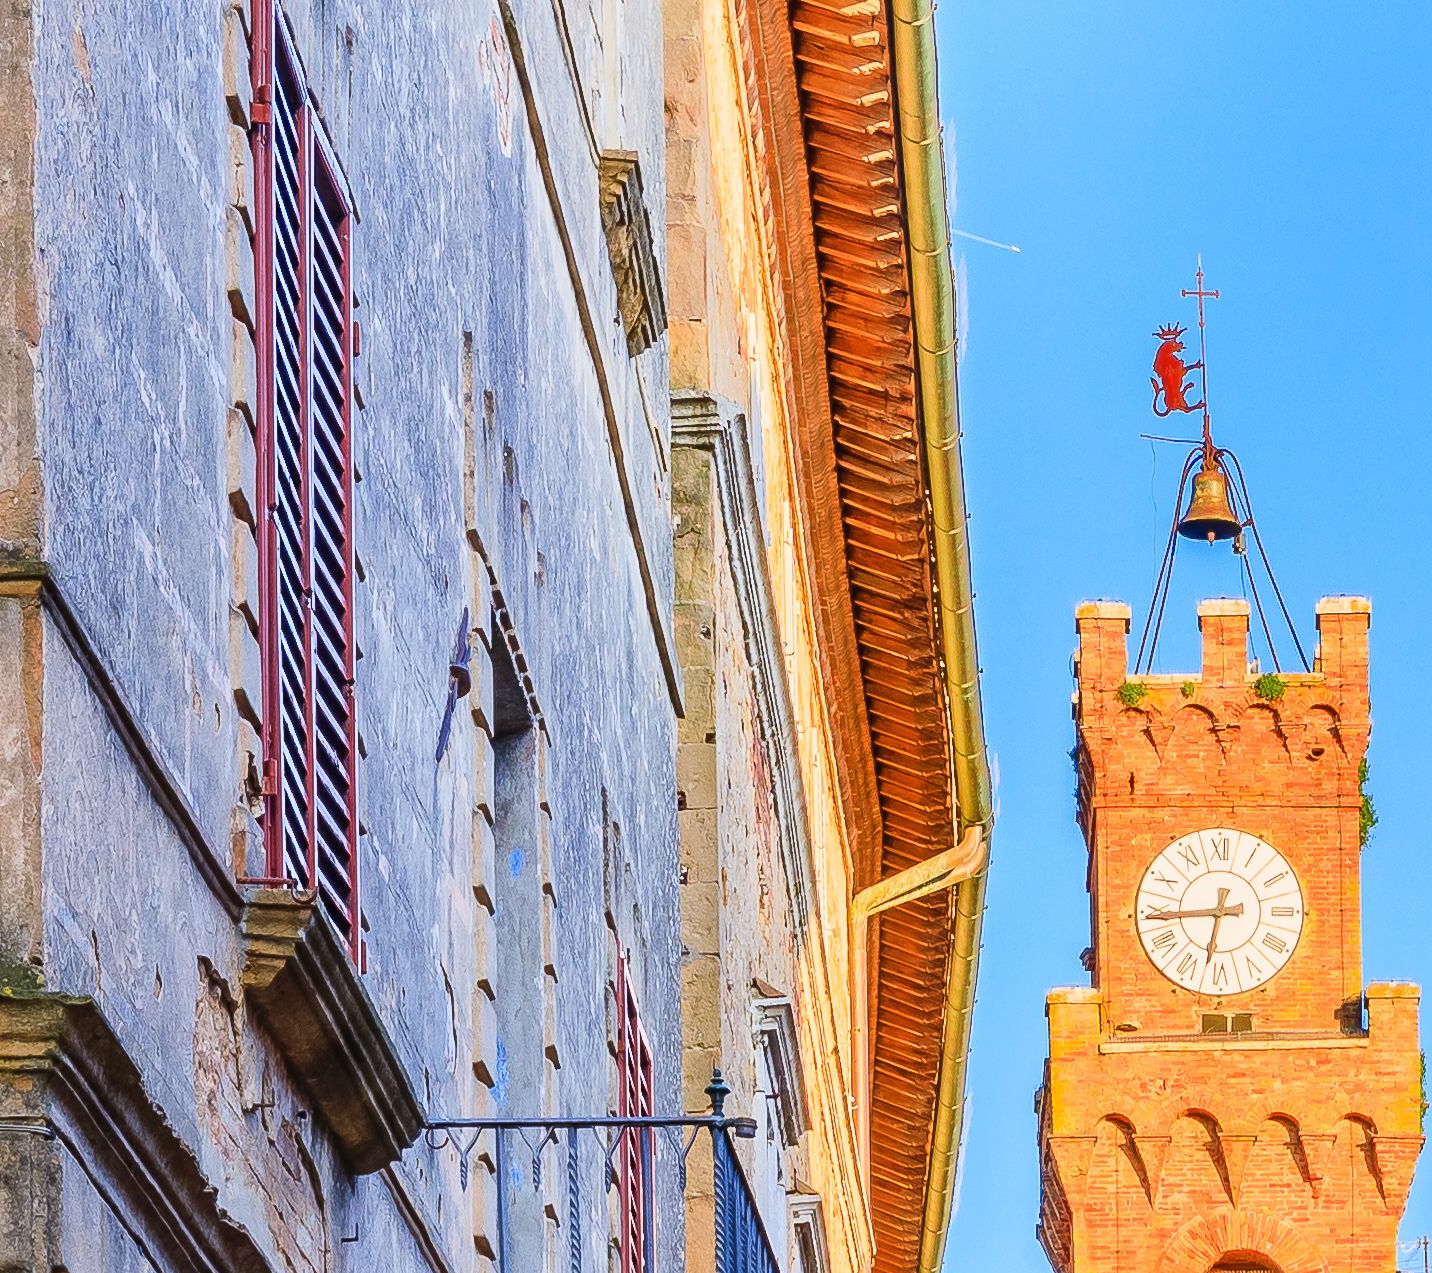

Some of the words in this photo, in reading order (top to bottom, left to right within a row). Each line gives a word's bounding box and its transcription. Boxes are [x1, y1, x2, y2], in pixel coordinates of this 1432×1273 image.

[1177, 844, 1200, 872] XI
[1211, 838, 1229, 861] XII
[1244, 848, 1257, 868] I
[1154, 870, 1179, 893] X
[1264, 873, 1285, 888] II
[1272, 907, 1294, 917] III
[1152, 930, 1178, 958] VIII
[1262, 932, 1287, 954] IIII
[1176, 952, 1198, 981] VII
[1213, 962, 1228, 985] VI
[1246, 955, 1262, 979] V
